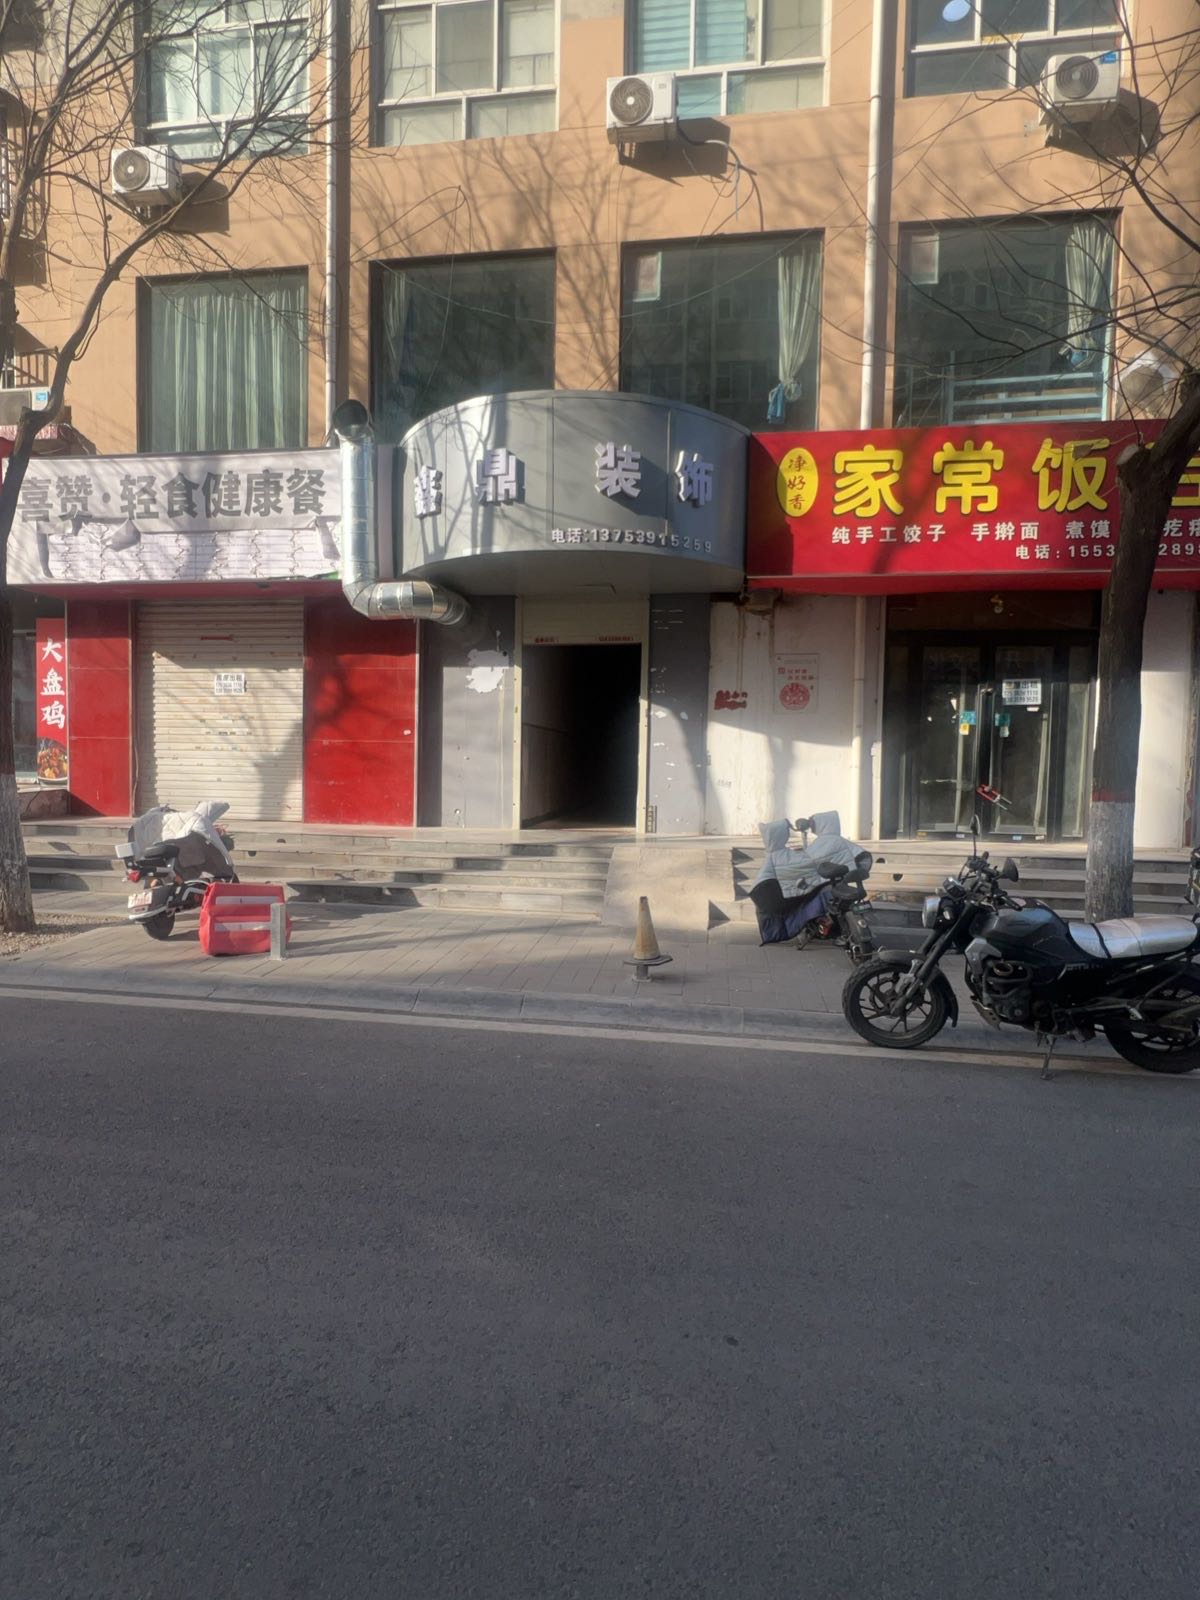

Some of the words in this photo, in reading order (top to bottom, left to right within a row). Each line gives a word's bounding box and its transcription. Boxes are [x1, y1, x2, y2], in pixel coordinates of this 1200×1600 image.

[832, 525, 946, 545] 纯手工饺子
[971, 521, 1039, 542] 手擀面
[40, 638, 66, 730] 大盘鸡
